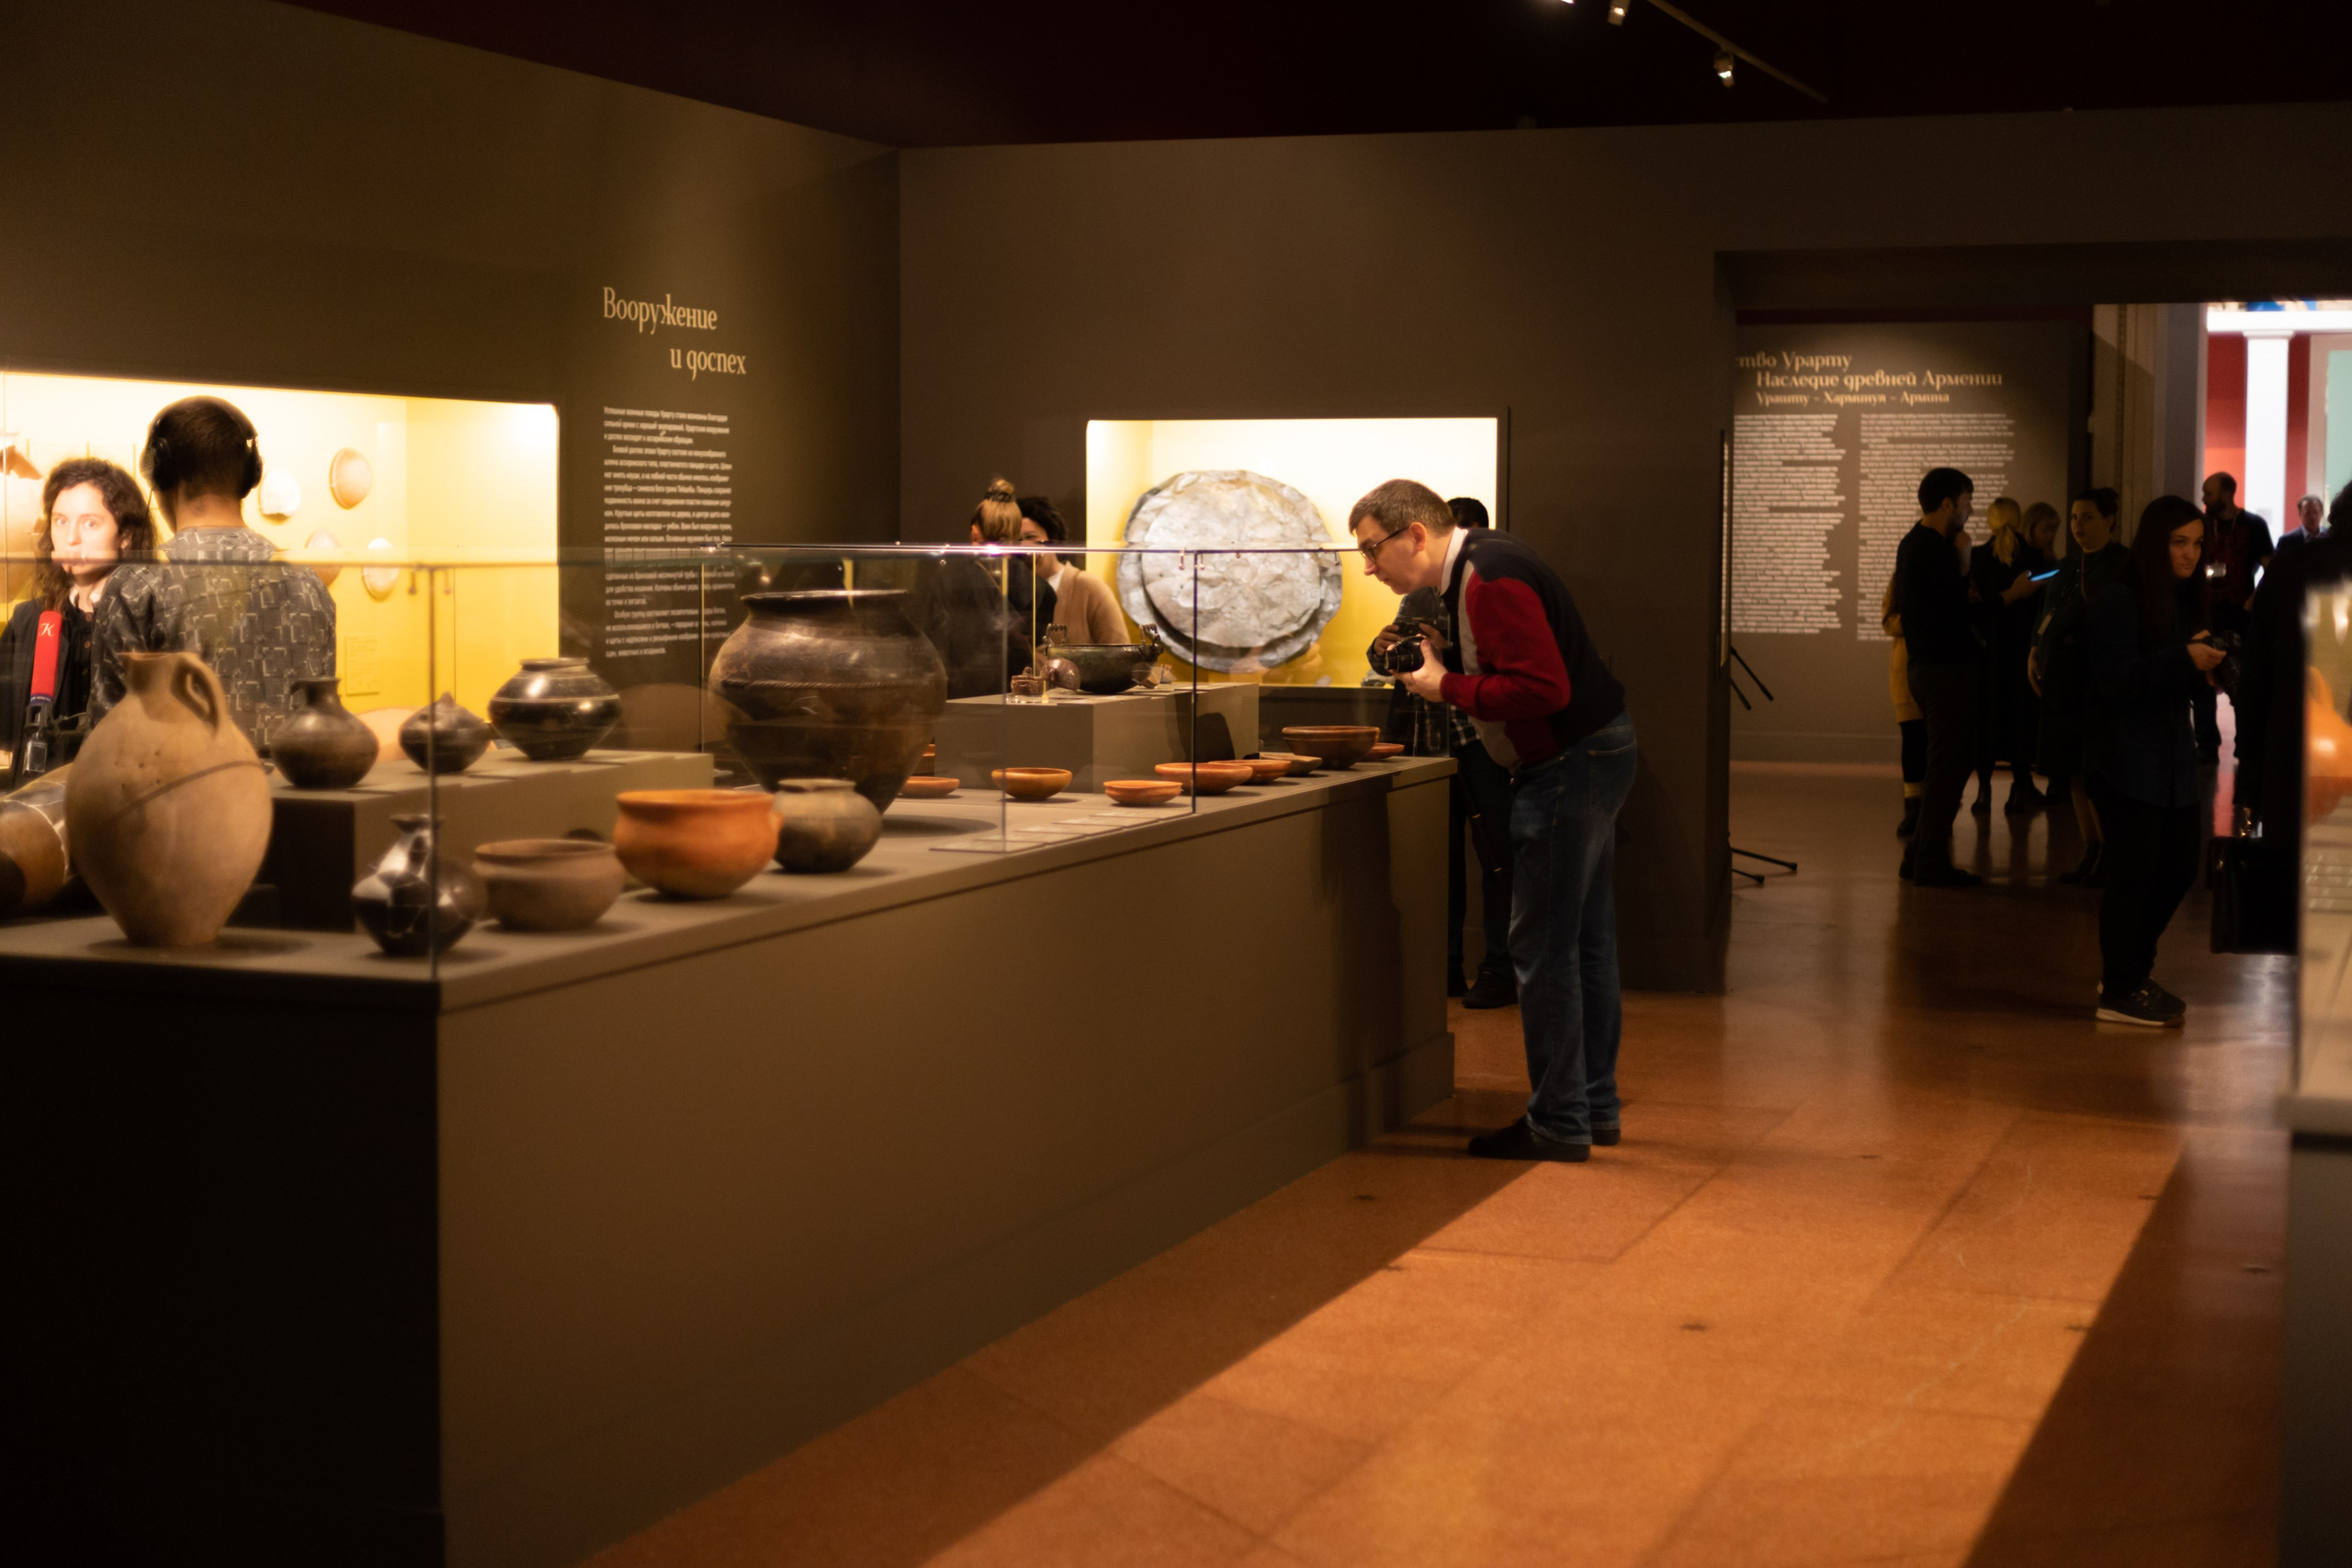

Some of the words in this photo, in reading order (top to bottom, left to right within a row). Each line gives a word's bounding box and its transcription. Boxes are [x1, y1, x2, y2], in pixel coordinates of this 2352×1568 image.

[603, 287, 718, 334] Вооружение
[670, 348, 682, 368] и
[686, 350, 746, 381] доспех
[1736, 351, 1777, 367] тво
[1781, 351, 1852, 373] Урарту
[1757, 370, 1839, 390] Наследие
[1843, 369, 1917, 392] древней
[1922, 369, 2003, 391] Армении
